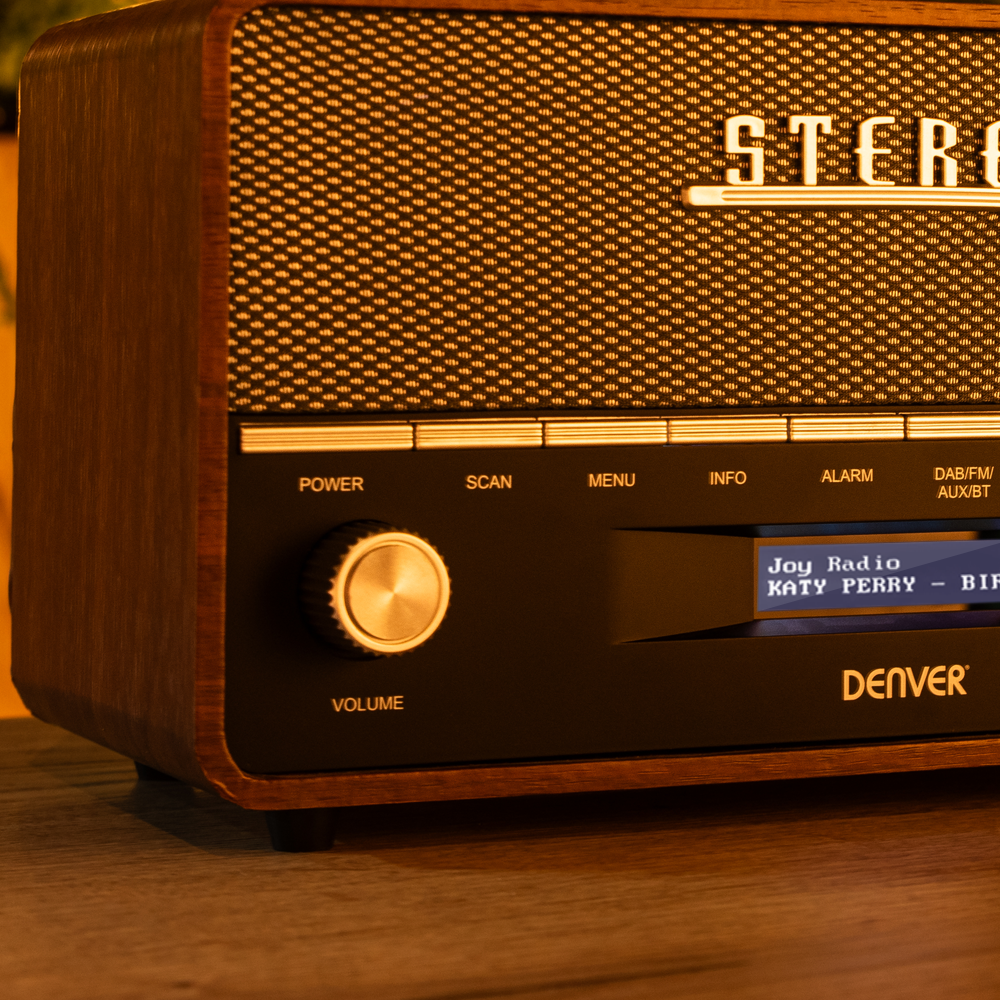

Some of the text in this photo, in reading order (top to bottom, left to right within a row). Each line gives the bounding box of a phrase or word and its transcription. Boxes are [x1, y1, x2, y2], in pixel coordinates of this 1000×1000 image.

[588, 472, 636, 488] MENU
[708, 470, 748, 486] INFO
[819, 468, 874, 484] ALARM
[933, 465, 995, 481] DAB/FM/
[298, 475, 364, 493] POWER
[465, 474, 513, 490] SCAN
[936, 484, 992, 499] AUX/BT
[767, 555, 901, 577] Joy Radio
[766, 578, 828, 597] KATY
[841, 575, 917, 595] PERRY
[841, 663, 971, 701] DENVER
[331, 695, 405, 713] VOLUME
